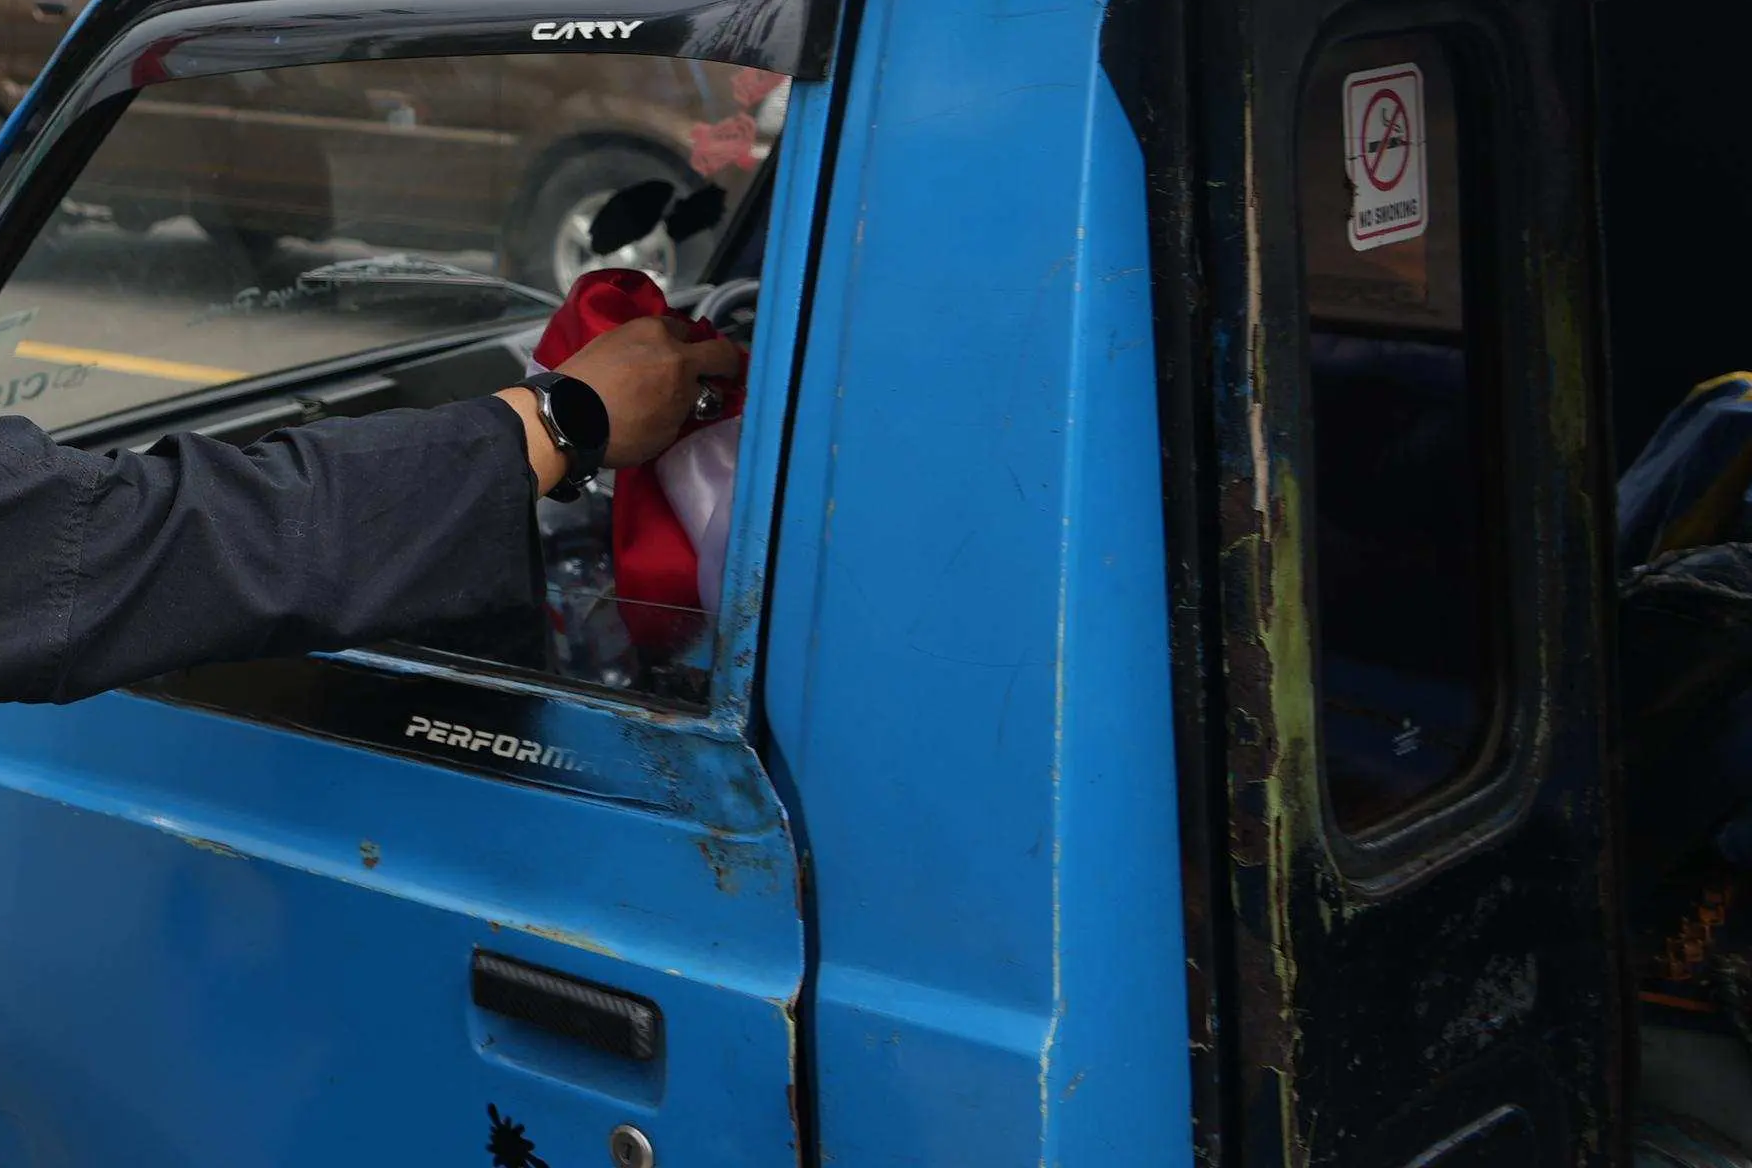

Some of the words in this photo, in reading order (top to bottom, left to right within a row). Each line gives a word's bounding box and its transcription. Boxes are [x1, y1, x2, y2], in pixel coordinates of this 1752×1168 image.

[531, 19, 645, 41] CARRY
[1358, 208, 1372, 228] NO
[1374, 198, 1417, 225] SMOKING
